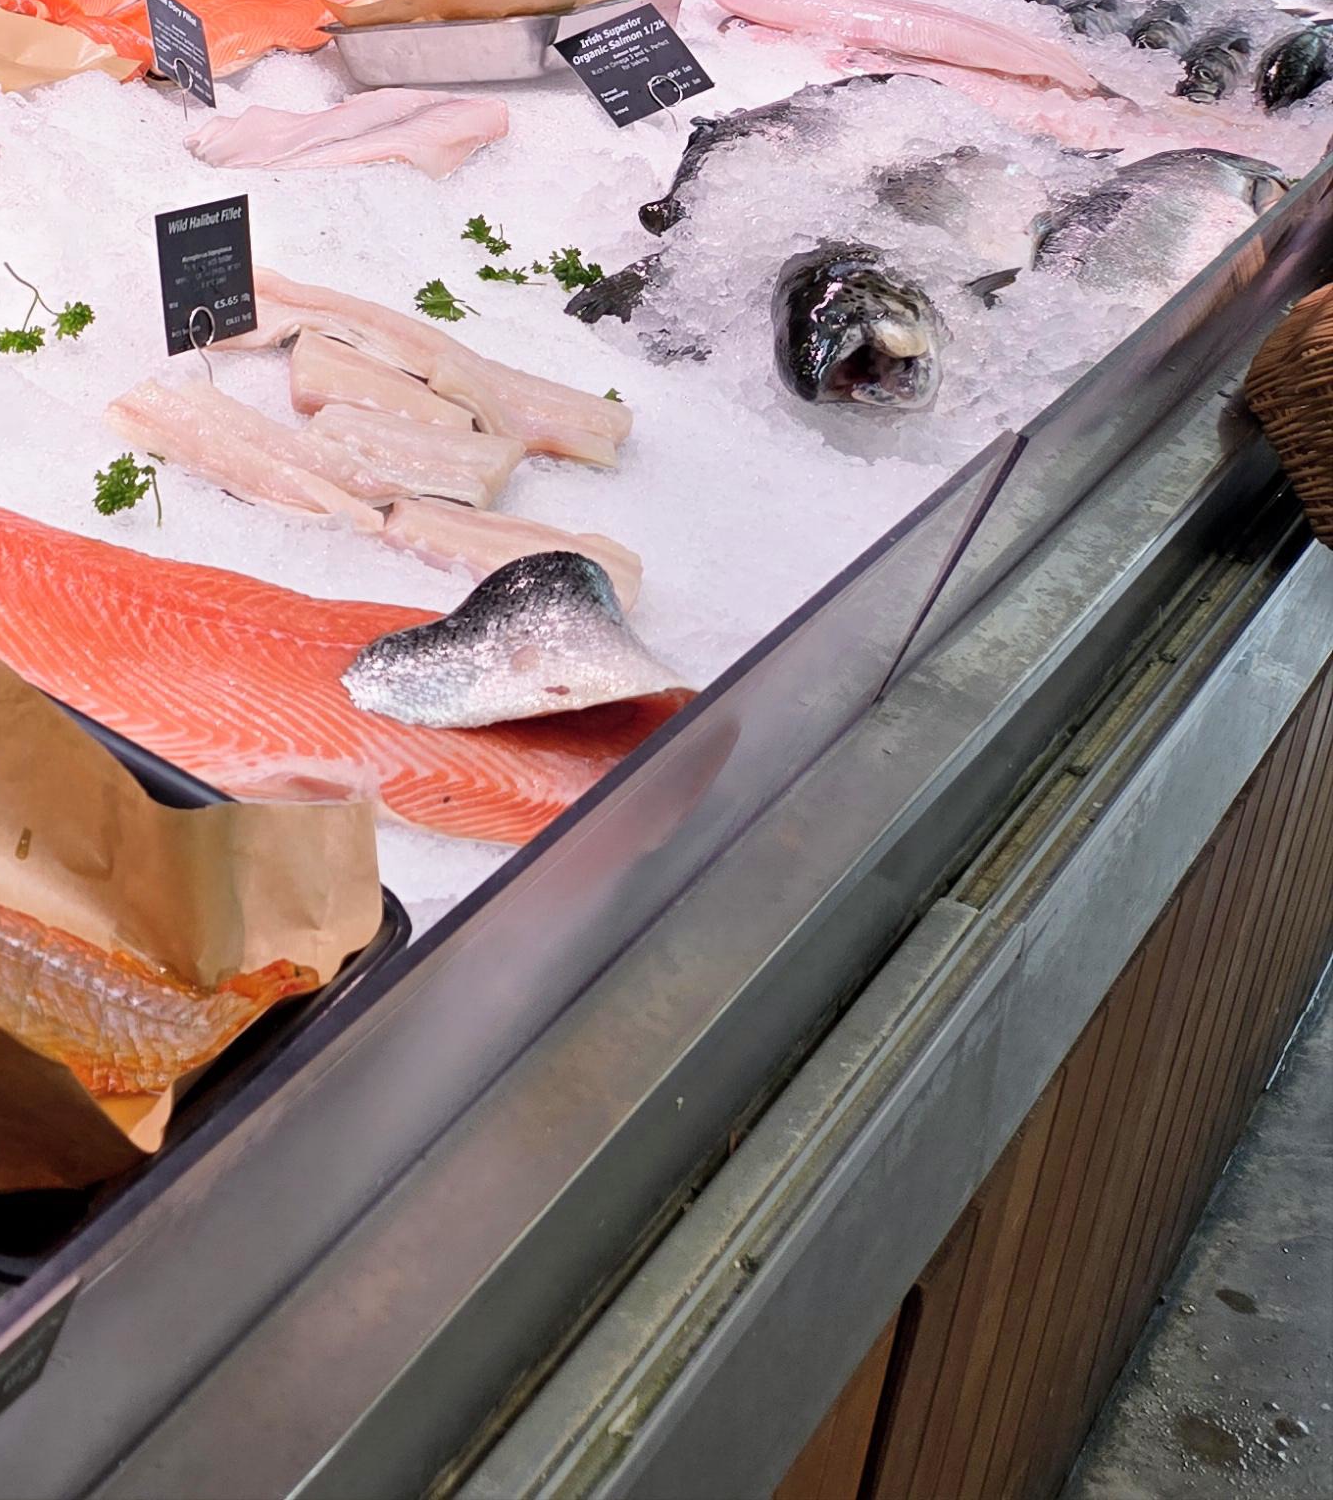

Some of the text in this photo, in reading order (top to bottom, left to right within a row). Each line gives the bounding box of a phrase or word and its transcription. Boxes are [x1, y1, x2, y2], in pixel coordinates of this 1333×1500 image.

[573, 45, 609, 65] Organic
[608, 31, 643, 50] Salmon
[580, 17, 641, 49] Irish Superior
[168, 206, 242, 235] Wild Halibut Fillet
